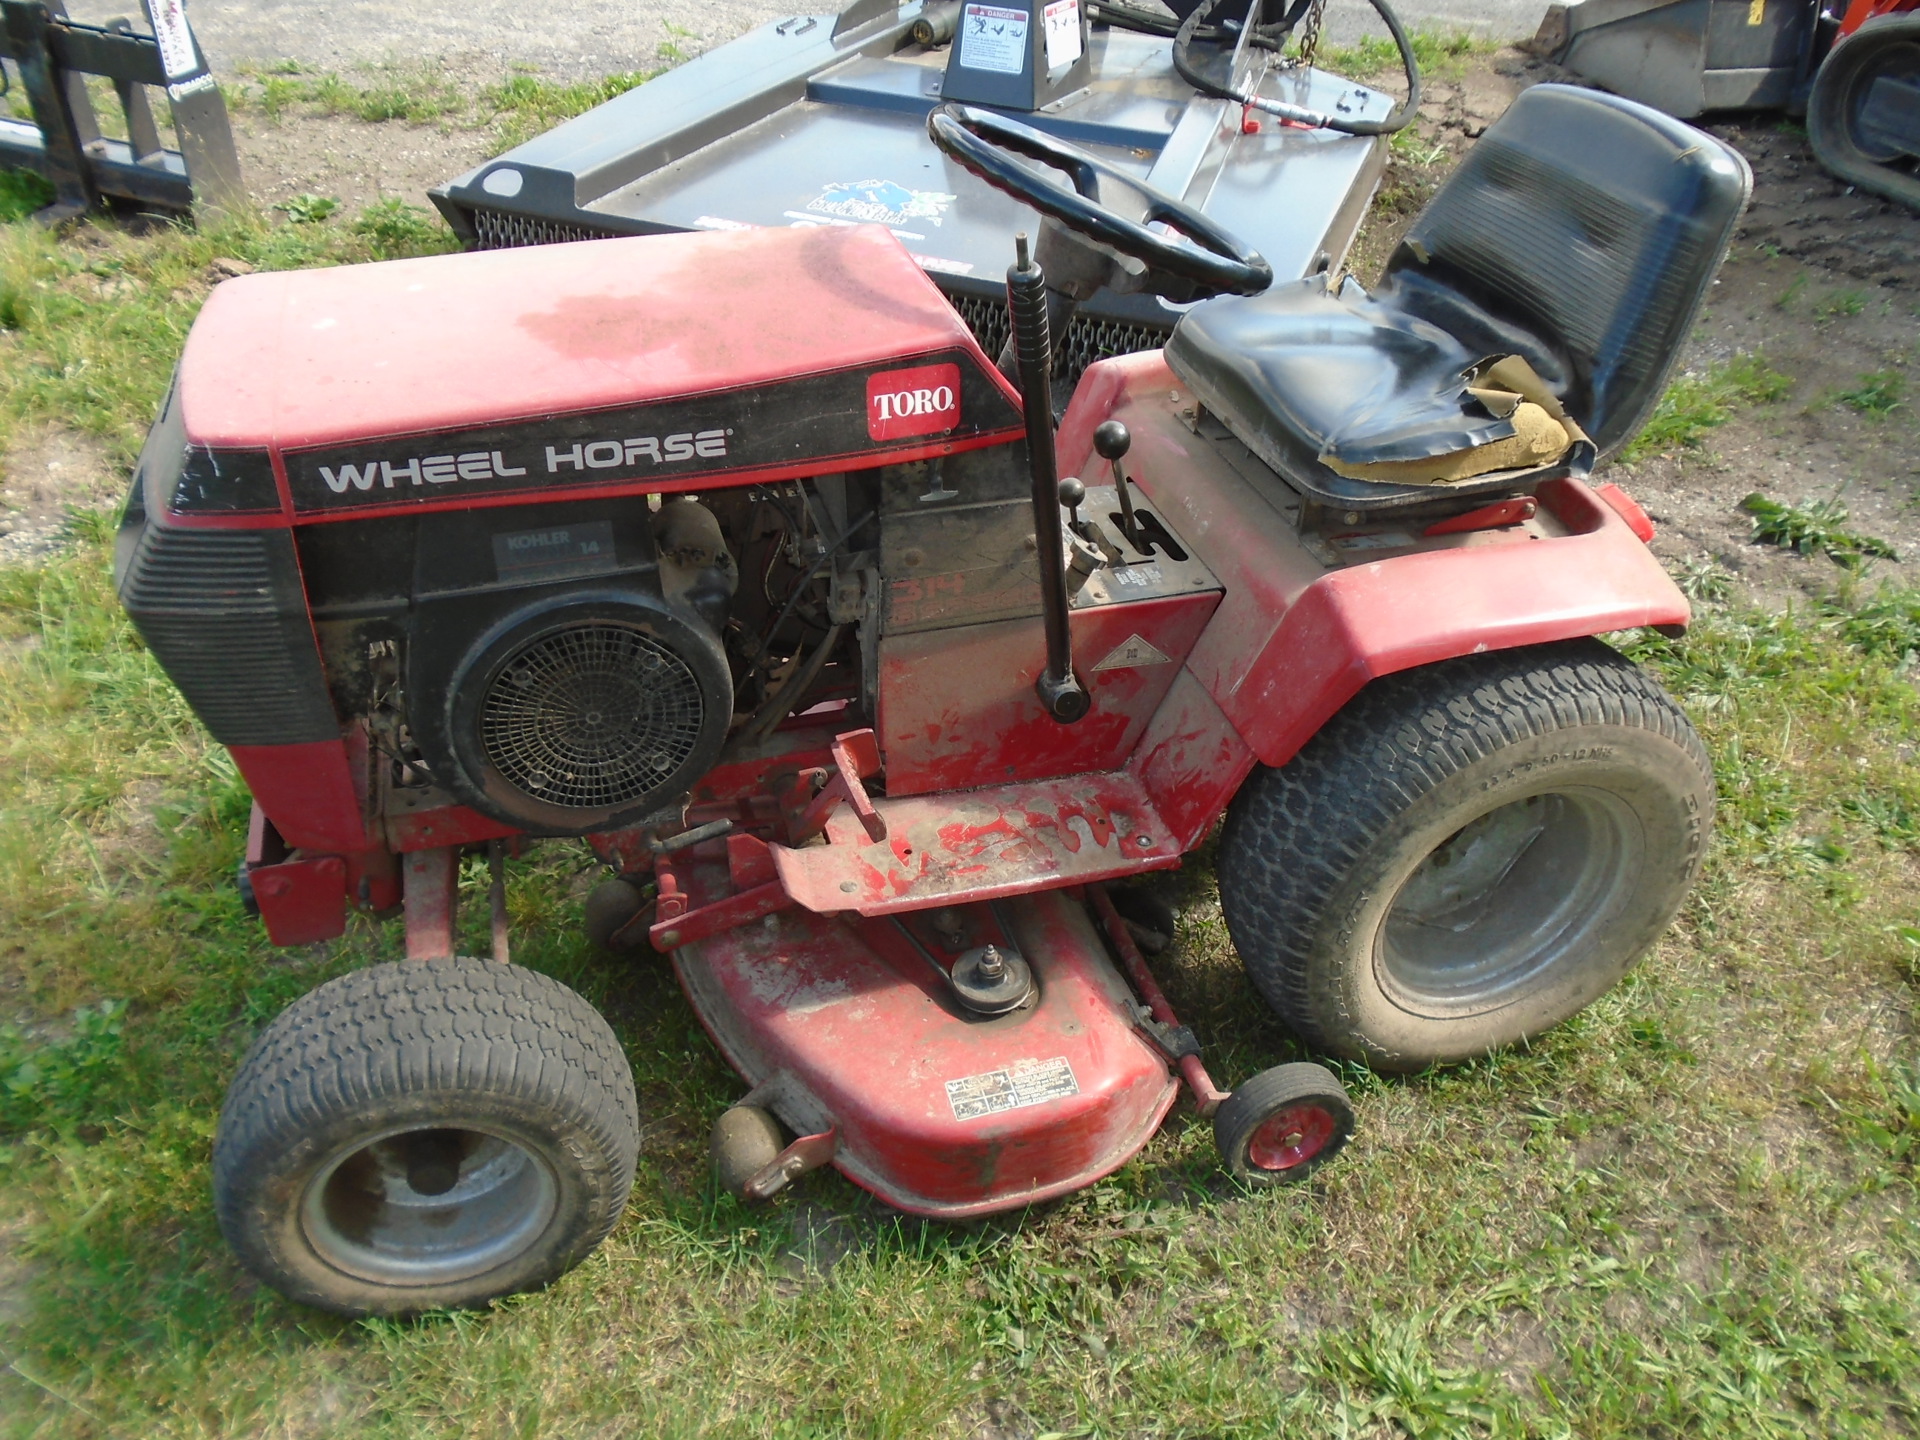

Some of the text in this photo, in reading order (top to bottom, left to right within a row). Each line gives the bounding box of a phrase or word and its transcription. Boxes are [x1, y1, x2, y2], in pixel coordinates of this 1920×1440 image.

[987, 9, 1015, 20] DANGER
[873, 386, 954, 420] TORO
[318, 429, 727, 493] WHEEL HORSE
[507, 531, 570, 550] KOHLER
[581, 540, 600, 555] 14
